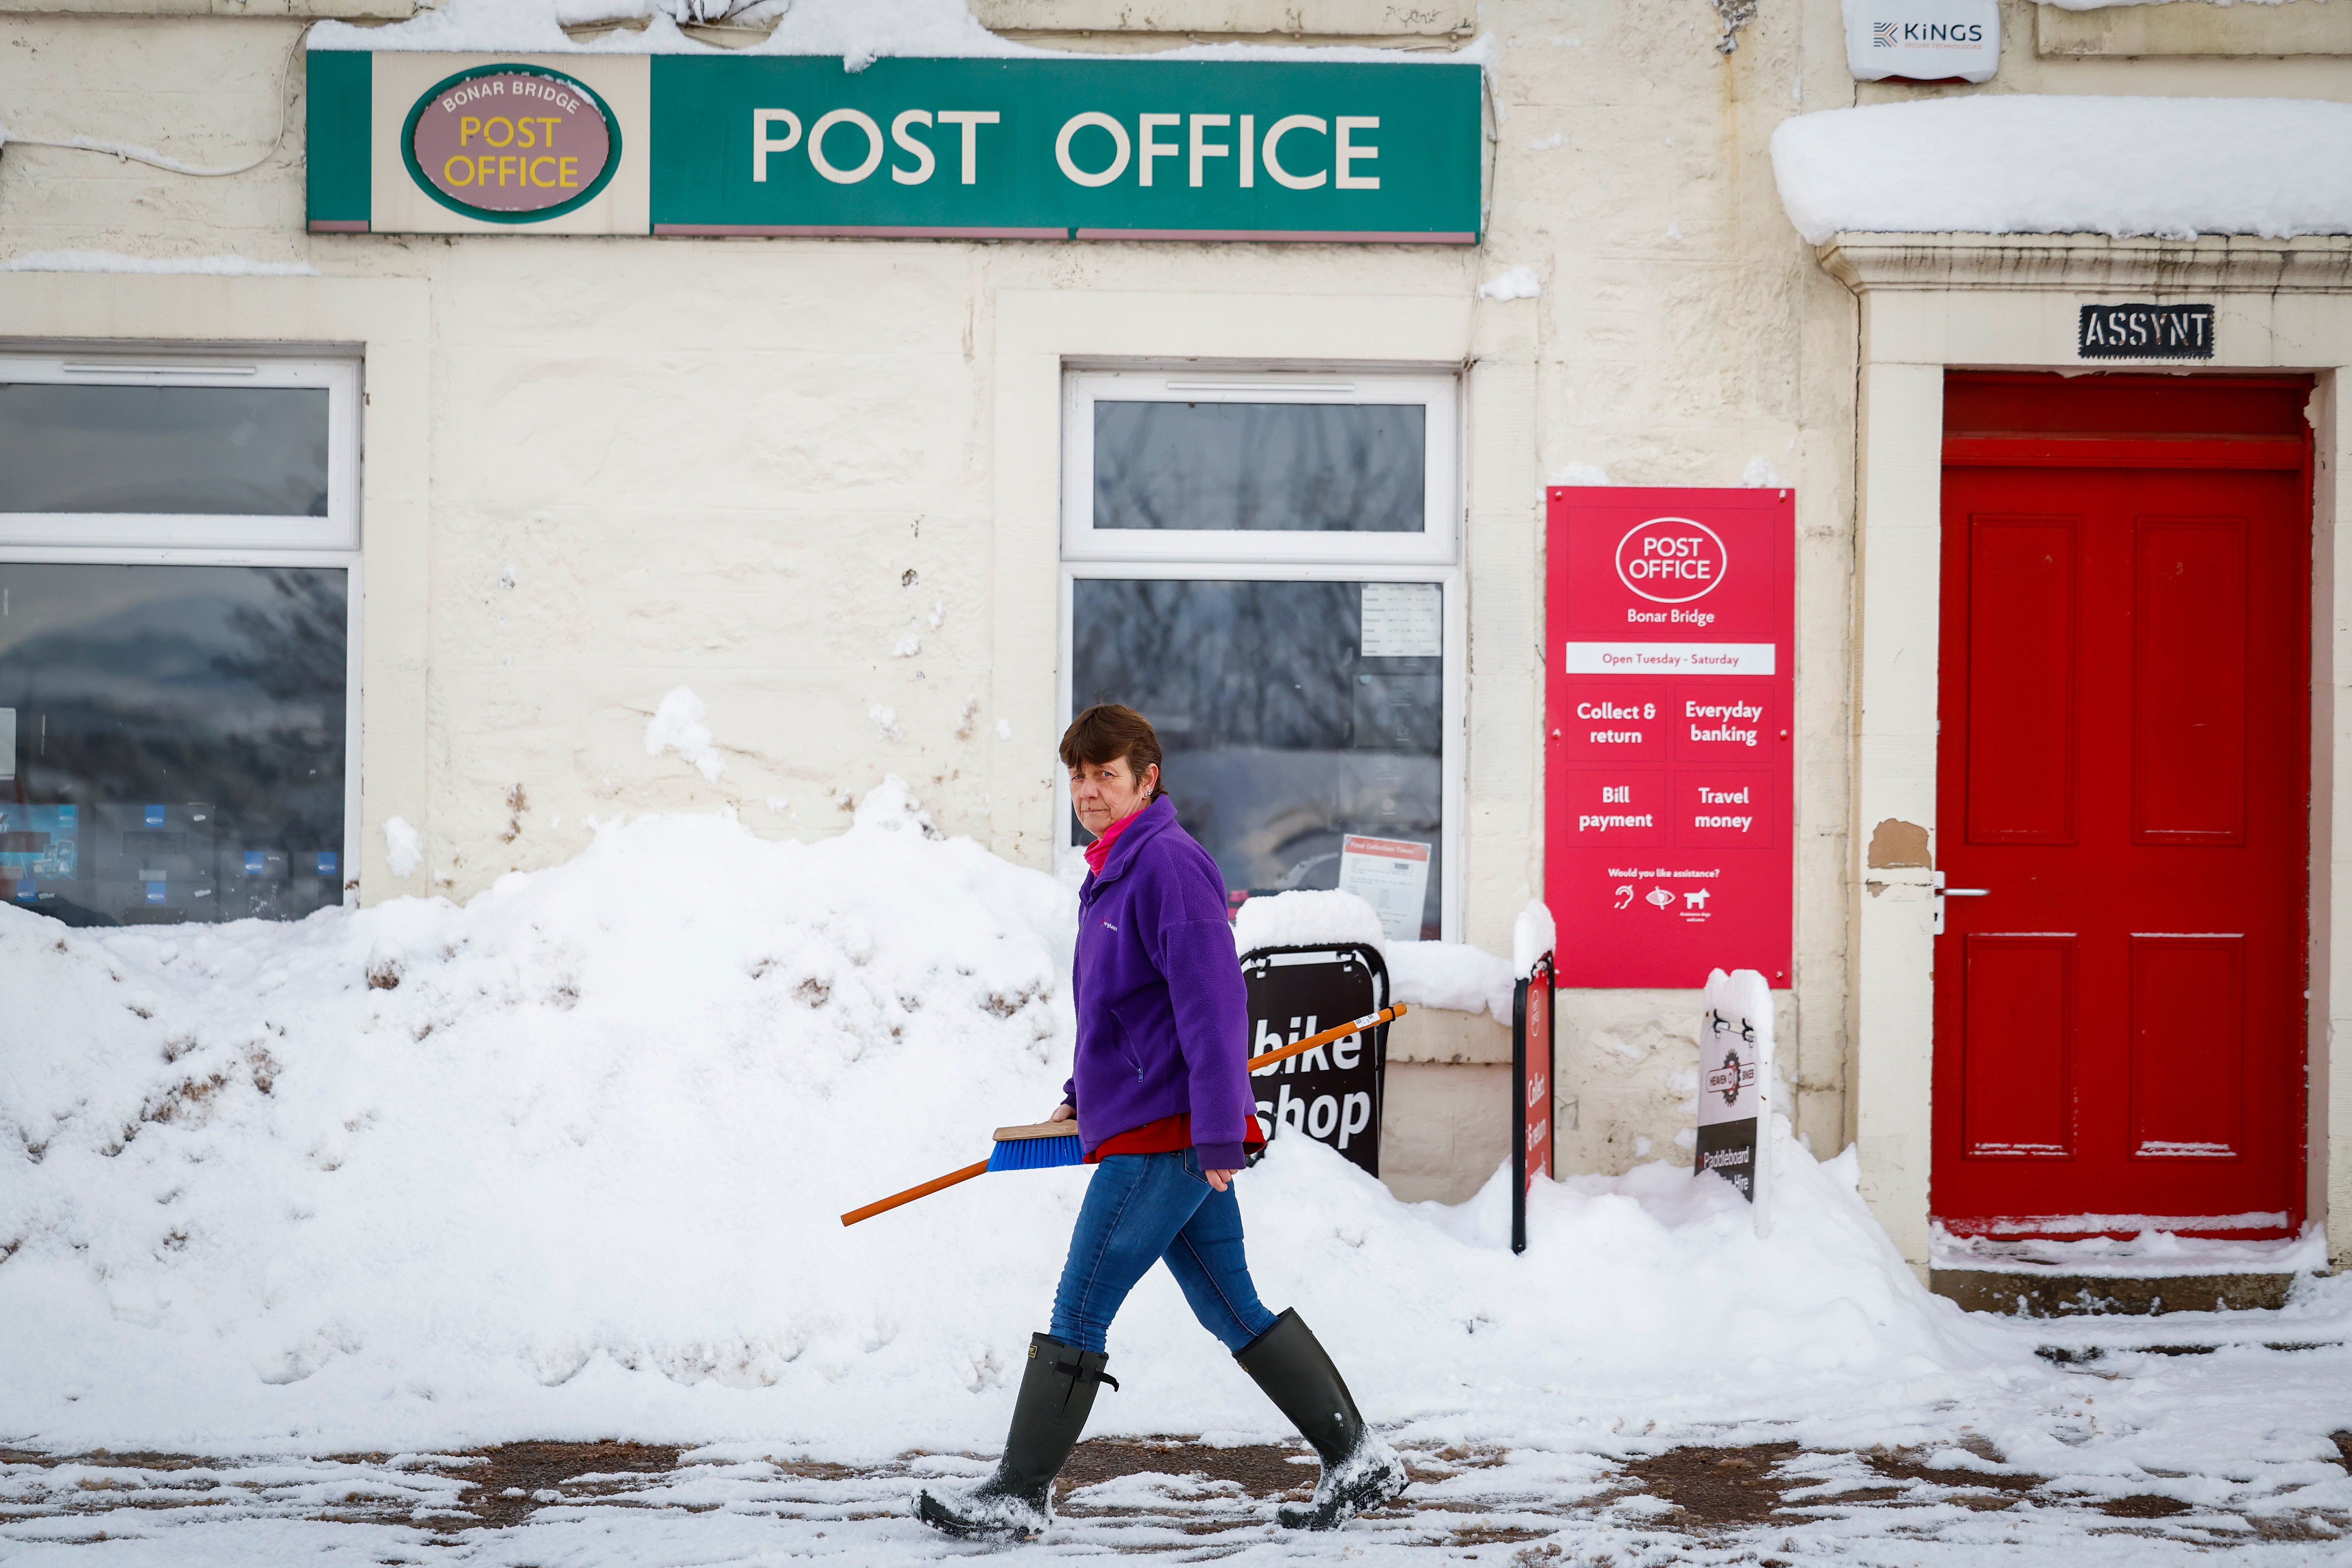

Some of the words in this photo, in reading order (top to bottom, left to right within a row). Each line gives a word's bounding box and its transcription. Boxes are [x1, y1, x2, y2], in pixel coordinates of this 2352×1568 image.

[442, 82, 505, 113] BONAR
[512, 82, 581, 115] BRIDGE
[461, 116, 561, 148] POST
[752, 108, 1000, 186] POST
[1055, 111, 1381, 190] OFFICE
[444, 155, 579, 188] OFFICE
[2085, 312, 2208, 347] ASSYNT
[1644, 537, 1703, 557] POST
[1629, 559, 1711, 579] OFFICE
[1628, 608, 1668, 623] Bonar
[1671, 609, 1715, 627] Bridge
[1602, 653, 1632, 667] Open
[1637, 653, 1680, 666] Tuesday
[1691, 654, 1739, 667] Saturday
[1577, 702, 1639, 720] Collect
[1643, 703, 1656, 720] &
[1686, 701, 1762, 722] Everyday
[1590, 729, 1642, 744] return
[1691, 724, 1758, 747] banking
[1602, 786, 1630, 804] Bill
[1698, 787, 1749, 804] Travel
[1579, 813, 1653, 832] payment
[1695, 816, 1752, 833] money
[1608, 868, 1637, 878] Would
[1639, 870, 1655, 880] you
[1656, 868, 1672, 878] like
[1673, 868, 1720, 878] assistance?
[1251, 1015, 1362, 1077] bike
[1710, 1074, 1727, 1086] HEAVEN
[1742, 1069, 1754, 1080] BIKES
[1256, 1084, 1371, 1150] shop
[1703, 1145, 1750, 1169] Paddleboard
[1734, 1174, 1749, 1191] Hire
